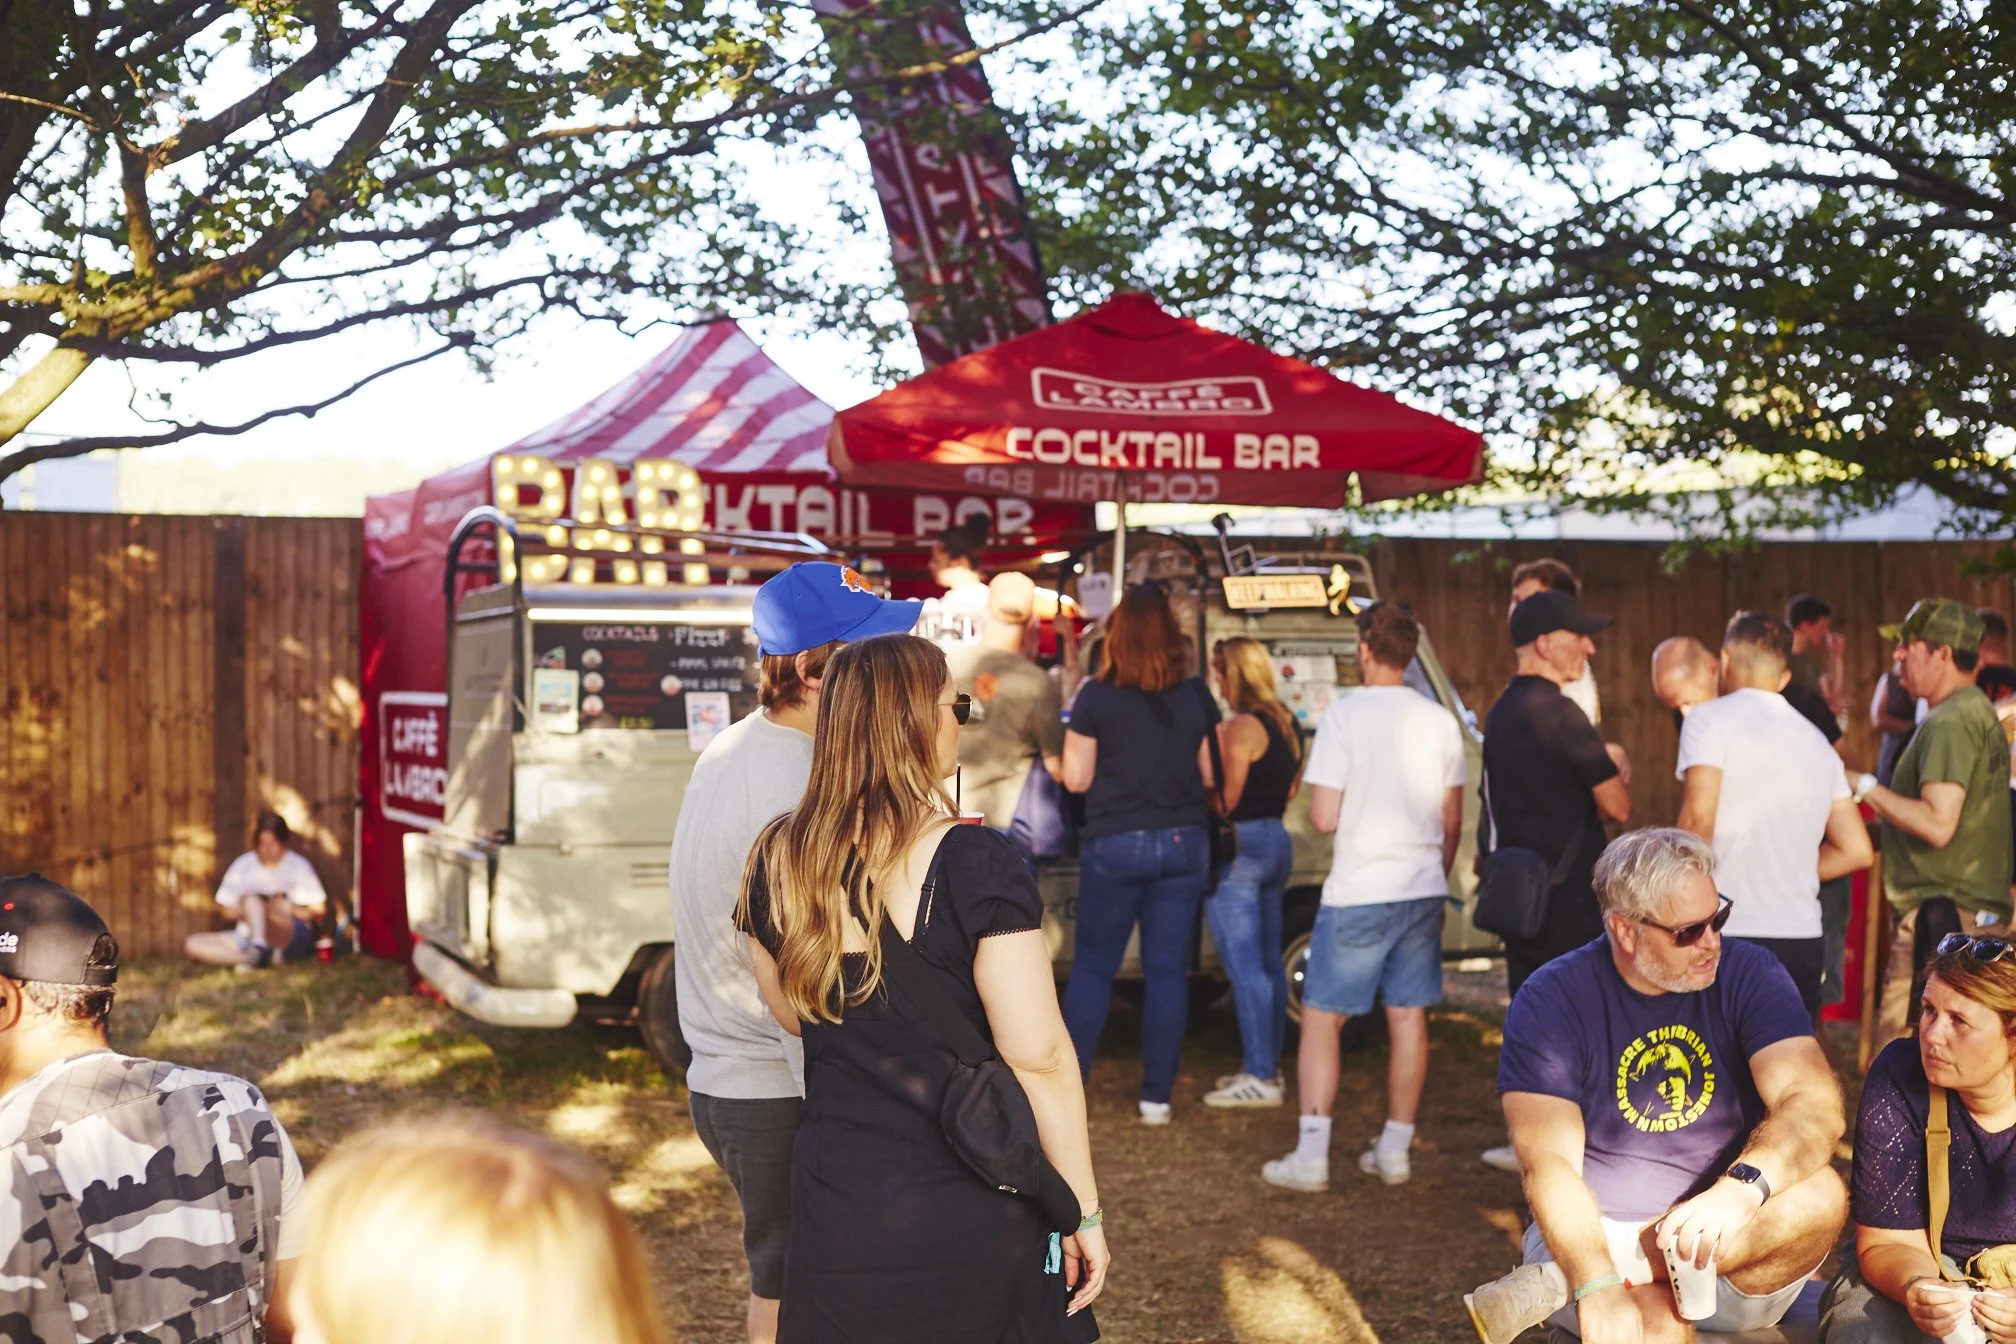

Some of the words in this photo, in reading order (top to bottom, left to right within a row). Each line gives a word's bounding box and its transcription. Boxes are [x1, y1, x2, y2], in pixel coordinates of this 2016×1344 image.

[1005, 426, 1223, 470] COCKTAIL
[1233, 432, 1320, 470] BAR
[491, 455, 711, 586] BAR
[1674, 1024, 1713, 1068] BRIAN
[1616, 1037, 1646, 1124] MASSACRE
[1635, 1071, 1715, 1133] JONESTOWN
